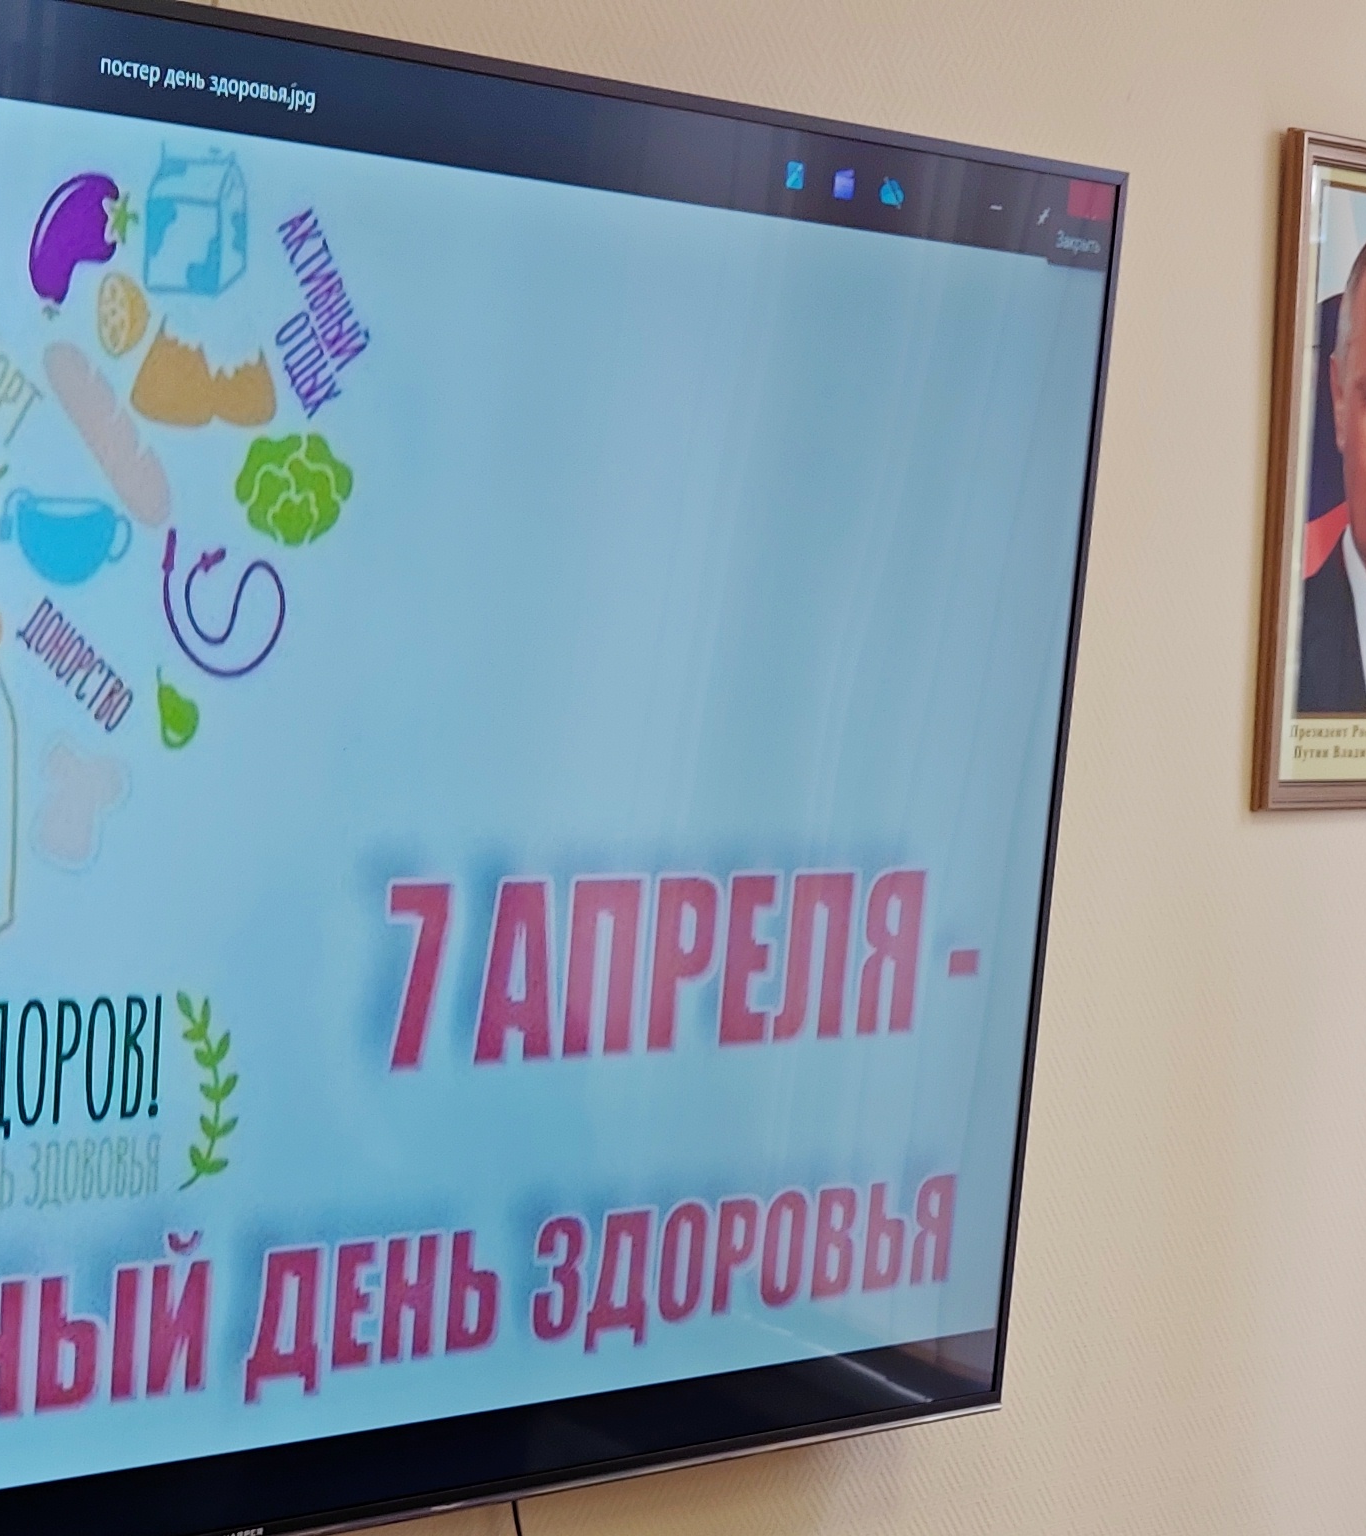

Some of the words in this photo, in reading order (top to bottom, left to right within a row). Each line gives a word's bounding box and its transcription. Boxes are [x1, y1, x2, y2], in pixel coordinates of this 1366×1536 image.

[100, 57, 160, 87] постер
[164, 69, 205, 89] день
[209, 75, 316, 113] здоровья.jpg
[278, 207, 370, 372] АКТИВНЫЙ
[276, 311, 342, 419] ОТДЫХ
[16, 598, 133, 732] ДОНОРСТВО
[388, 883, 453, 1071] 7
[474, 869, 928, 1065] АПРЕЛЯ
[242, 1230, 499, 1402] ДЕНЬ
[531, 1174, 957, 1354] ЗДОРОВЬЯ
